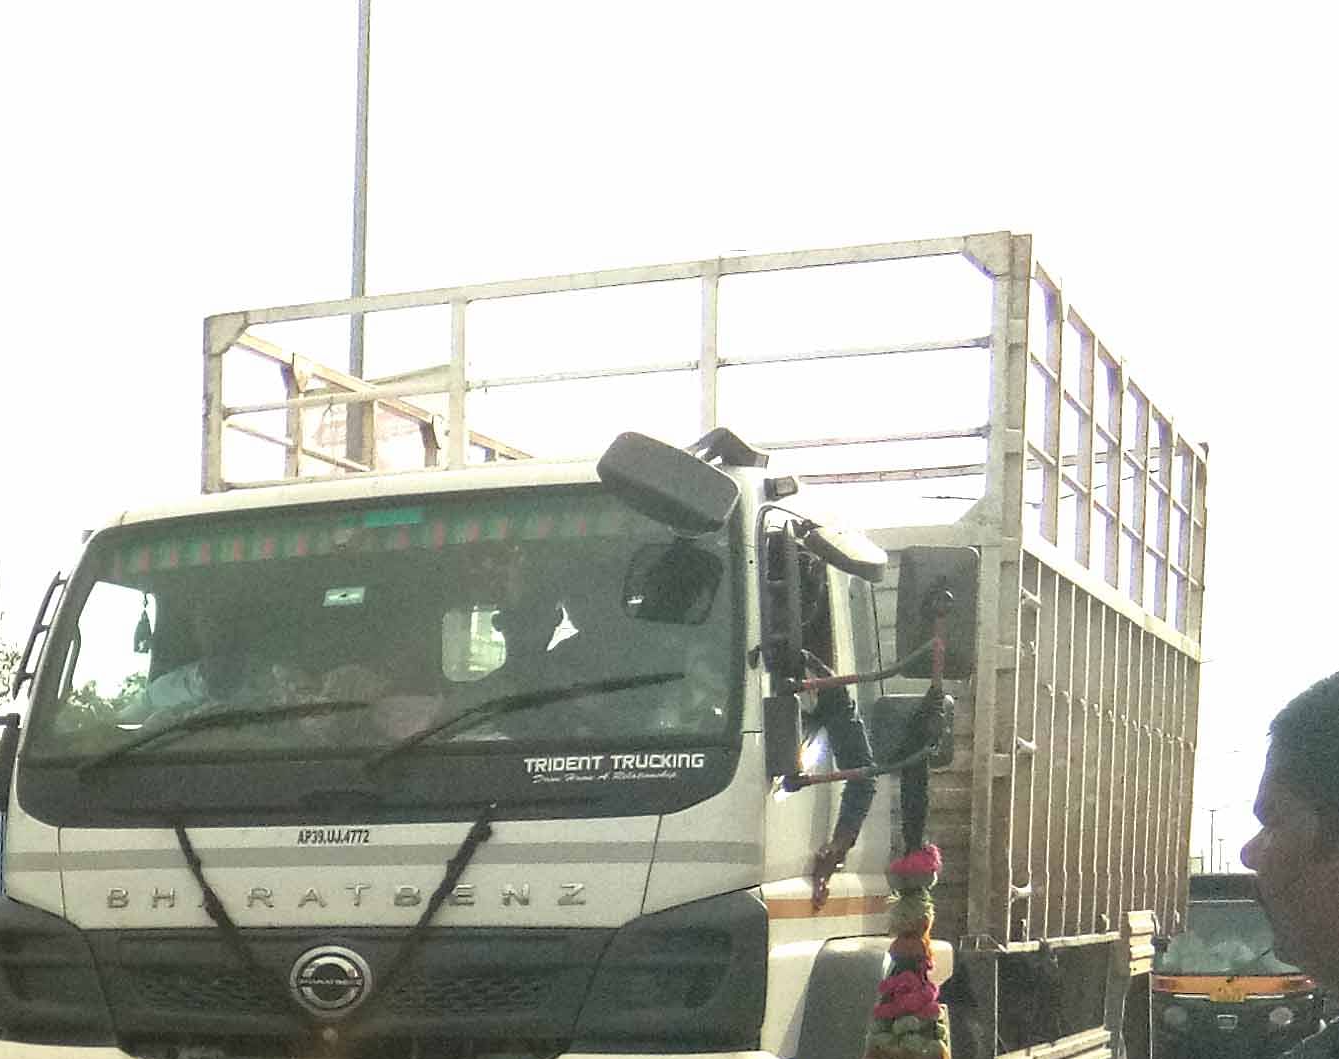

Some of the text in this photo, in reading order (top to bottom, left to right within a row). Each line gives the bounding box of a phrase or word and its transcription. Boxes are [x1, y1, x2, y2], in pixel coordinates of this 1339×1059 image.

[524, 753, 705, 773] TRIDENT TRUCKING
[107, 881, 587, 909] BHRATBENZ
